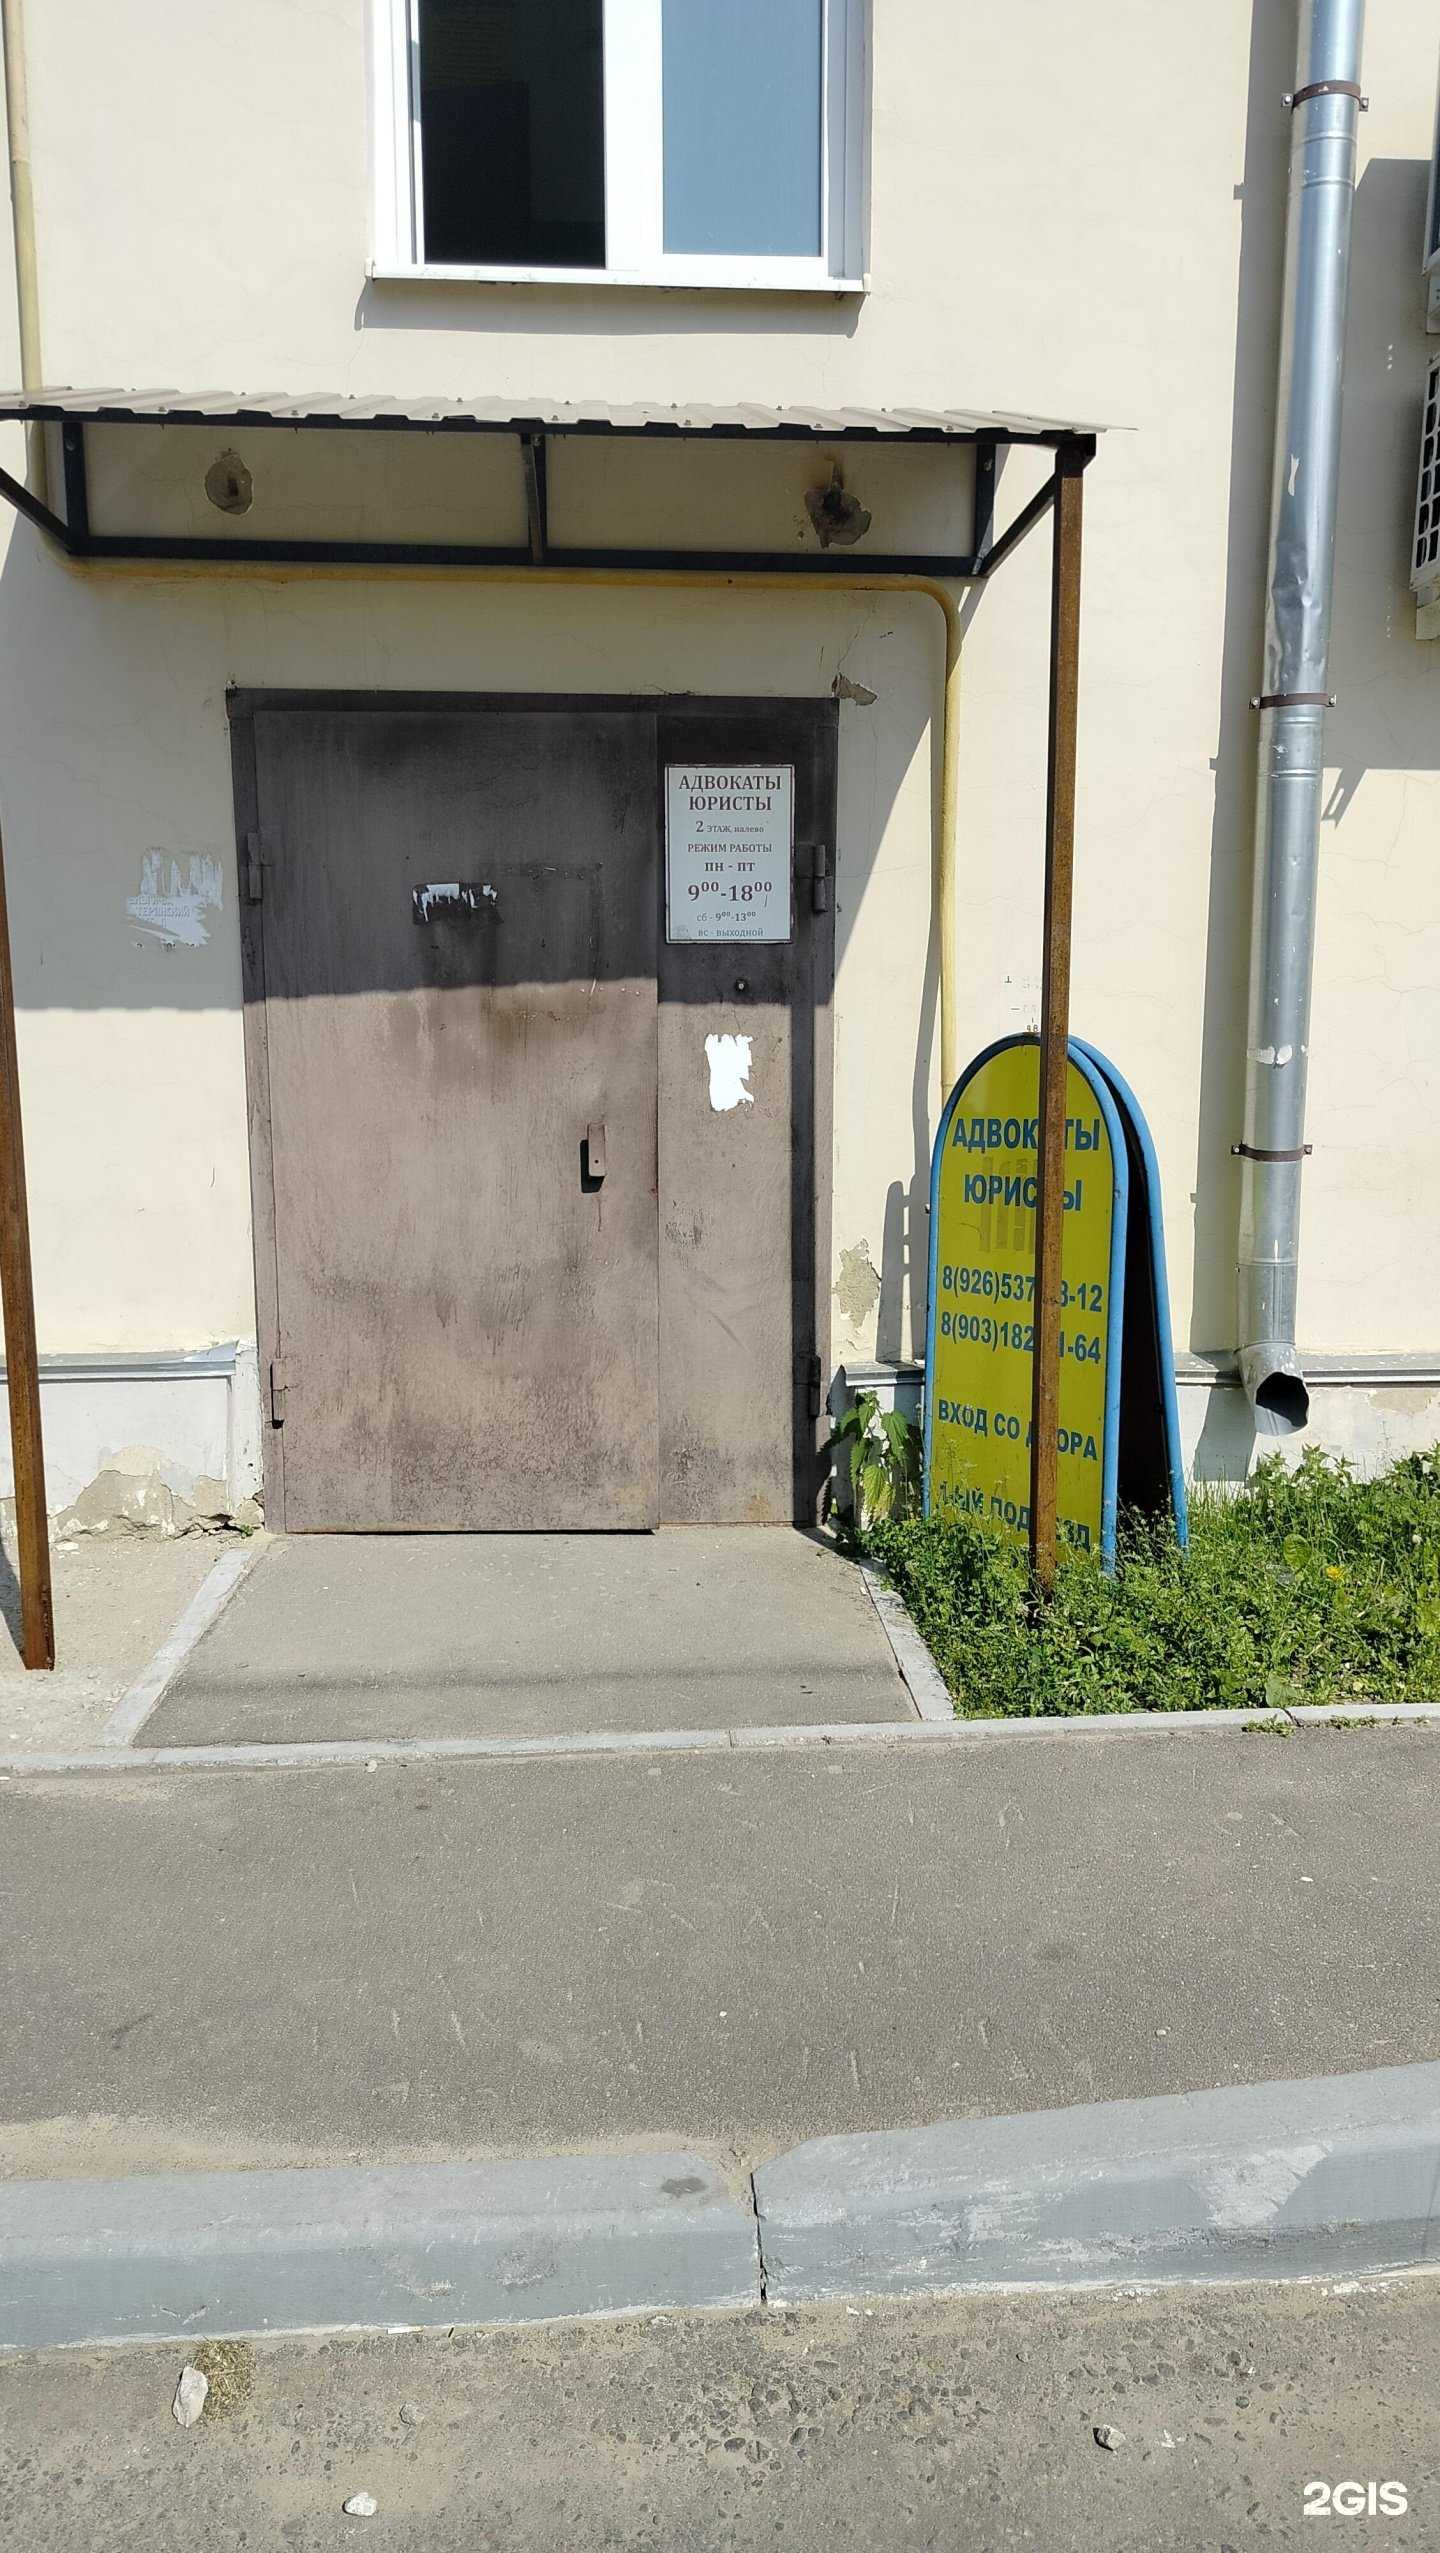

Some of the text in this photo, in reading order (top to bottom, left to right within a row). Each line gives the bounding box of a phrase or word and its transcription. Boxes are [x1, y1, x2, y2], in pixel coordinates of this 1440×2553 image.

[679, 775, 781, 792] АДВОКАТЫ
[689, 796, 772, 811] ЮРИСТЫ
[695, 820, 704, 833] 2
[687, 843, 772, 853] РЕЖИМ РАБОТЫ
[952, 1118, 1101, 1154] АДВОКТЫ
[964, 1173, 1083, 1212] ЮРИСЫ
[938, 1399, 988, 1437] ВХОД
[994, 1412, 1020, 1440] СО
